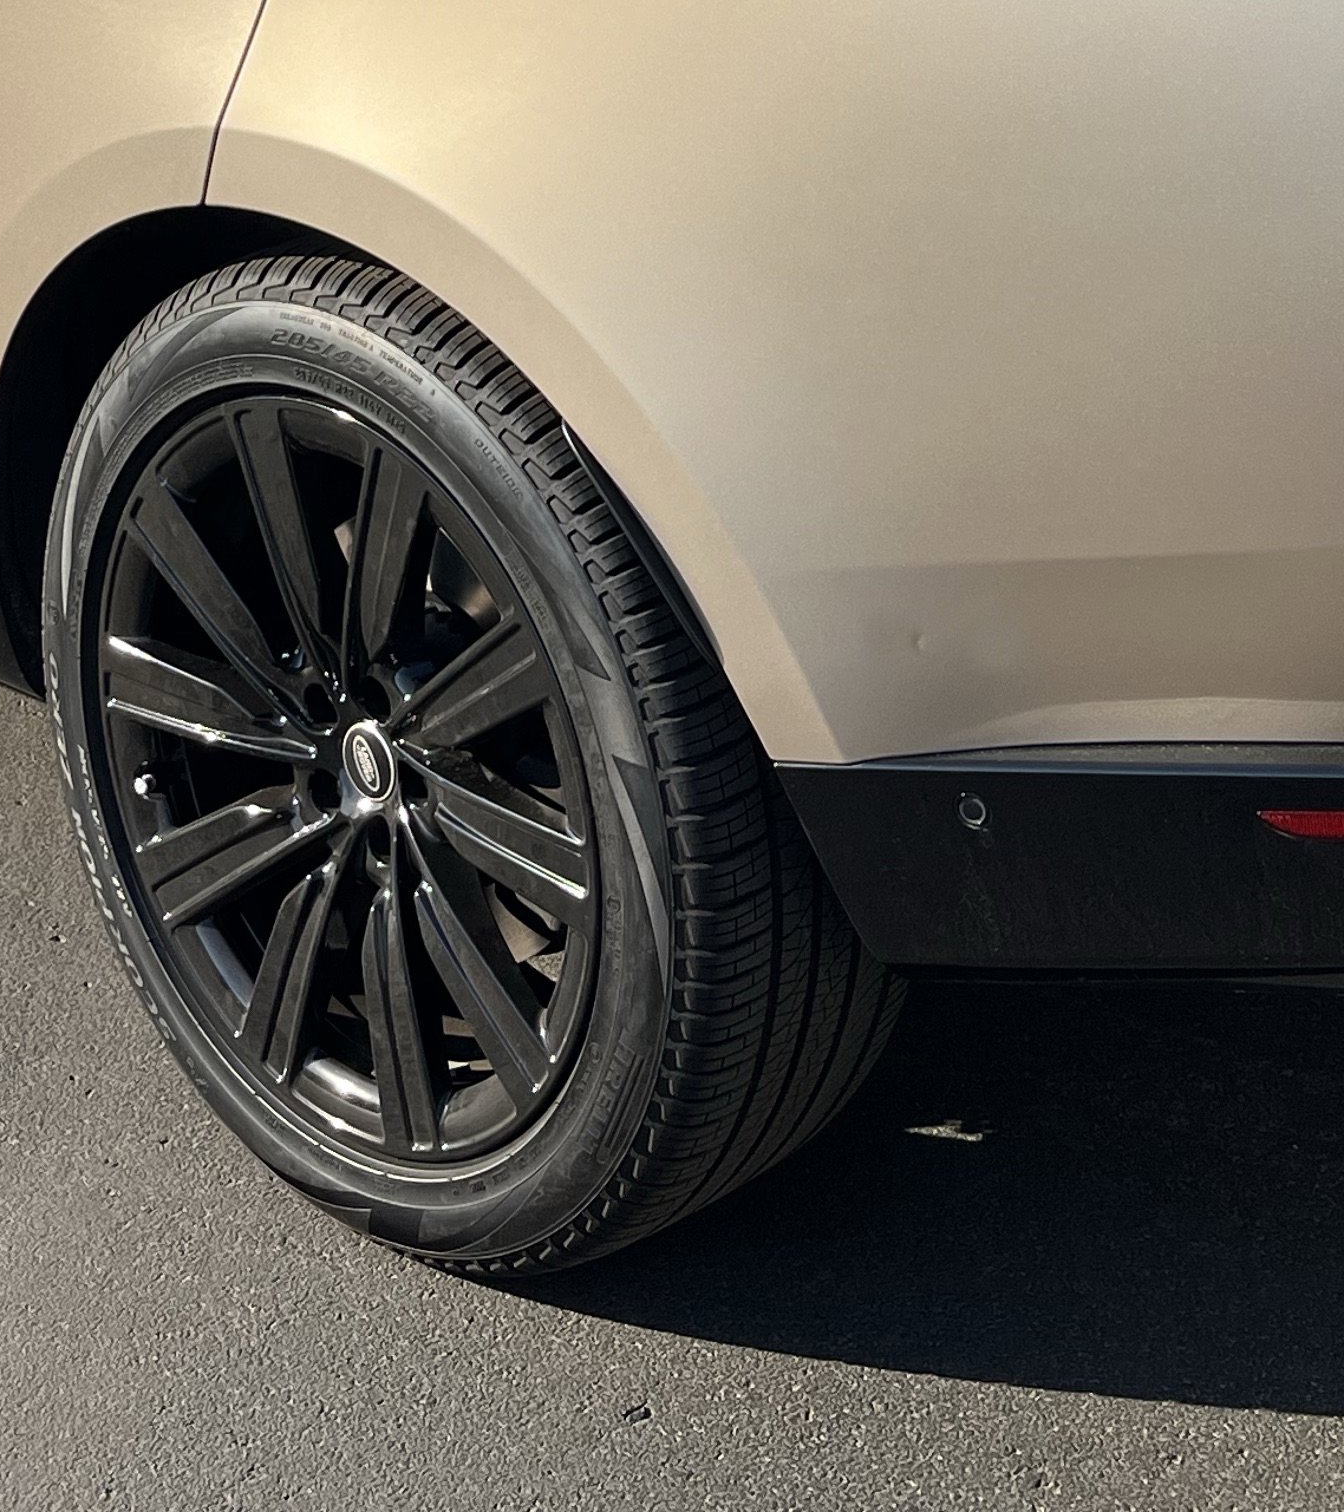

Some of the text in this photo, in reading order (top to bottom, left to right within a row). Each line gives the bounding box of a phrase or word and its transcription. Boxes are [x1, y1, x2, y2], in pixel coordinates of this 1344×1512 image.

[373, 370, 436, 423] R22
[50, 652, 178, 1041] SCORPION ZERO
